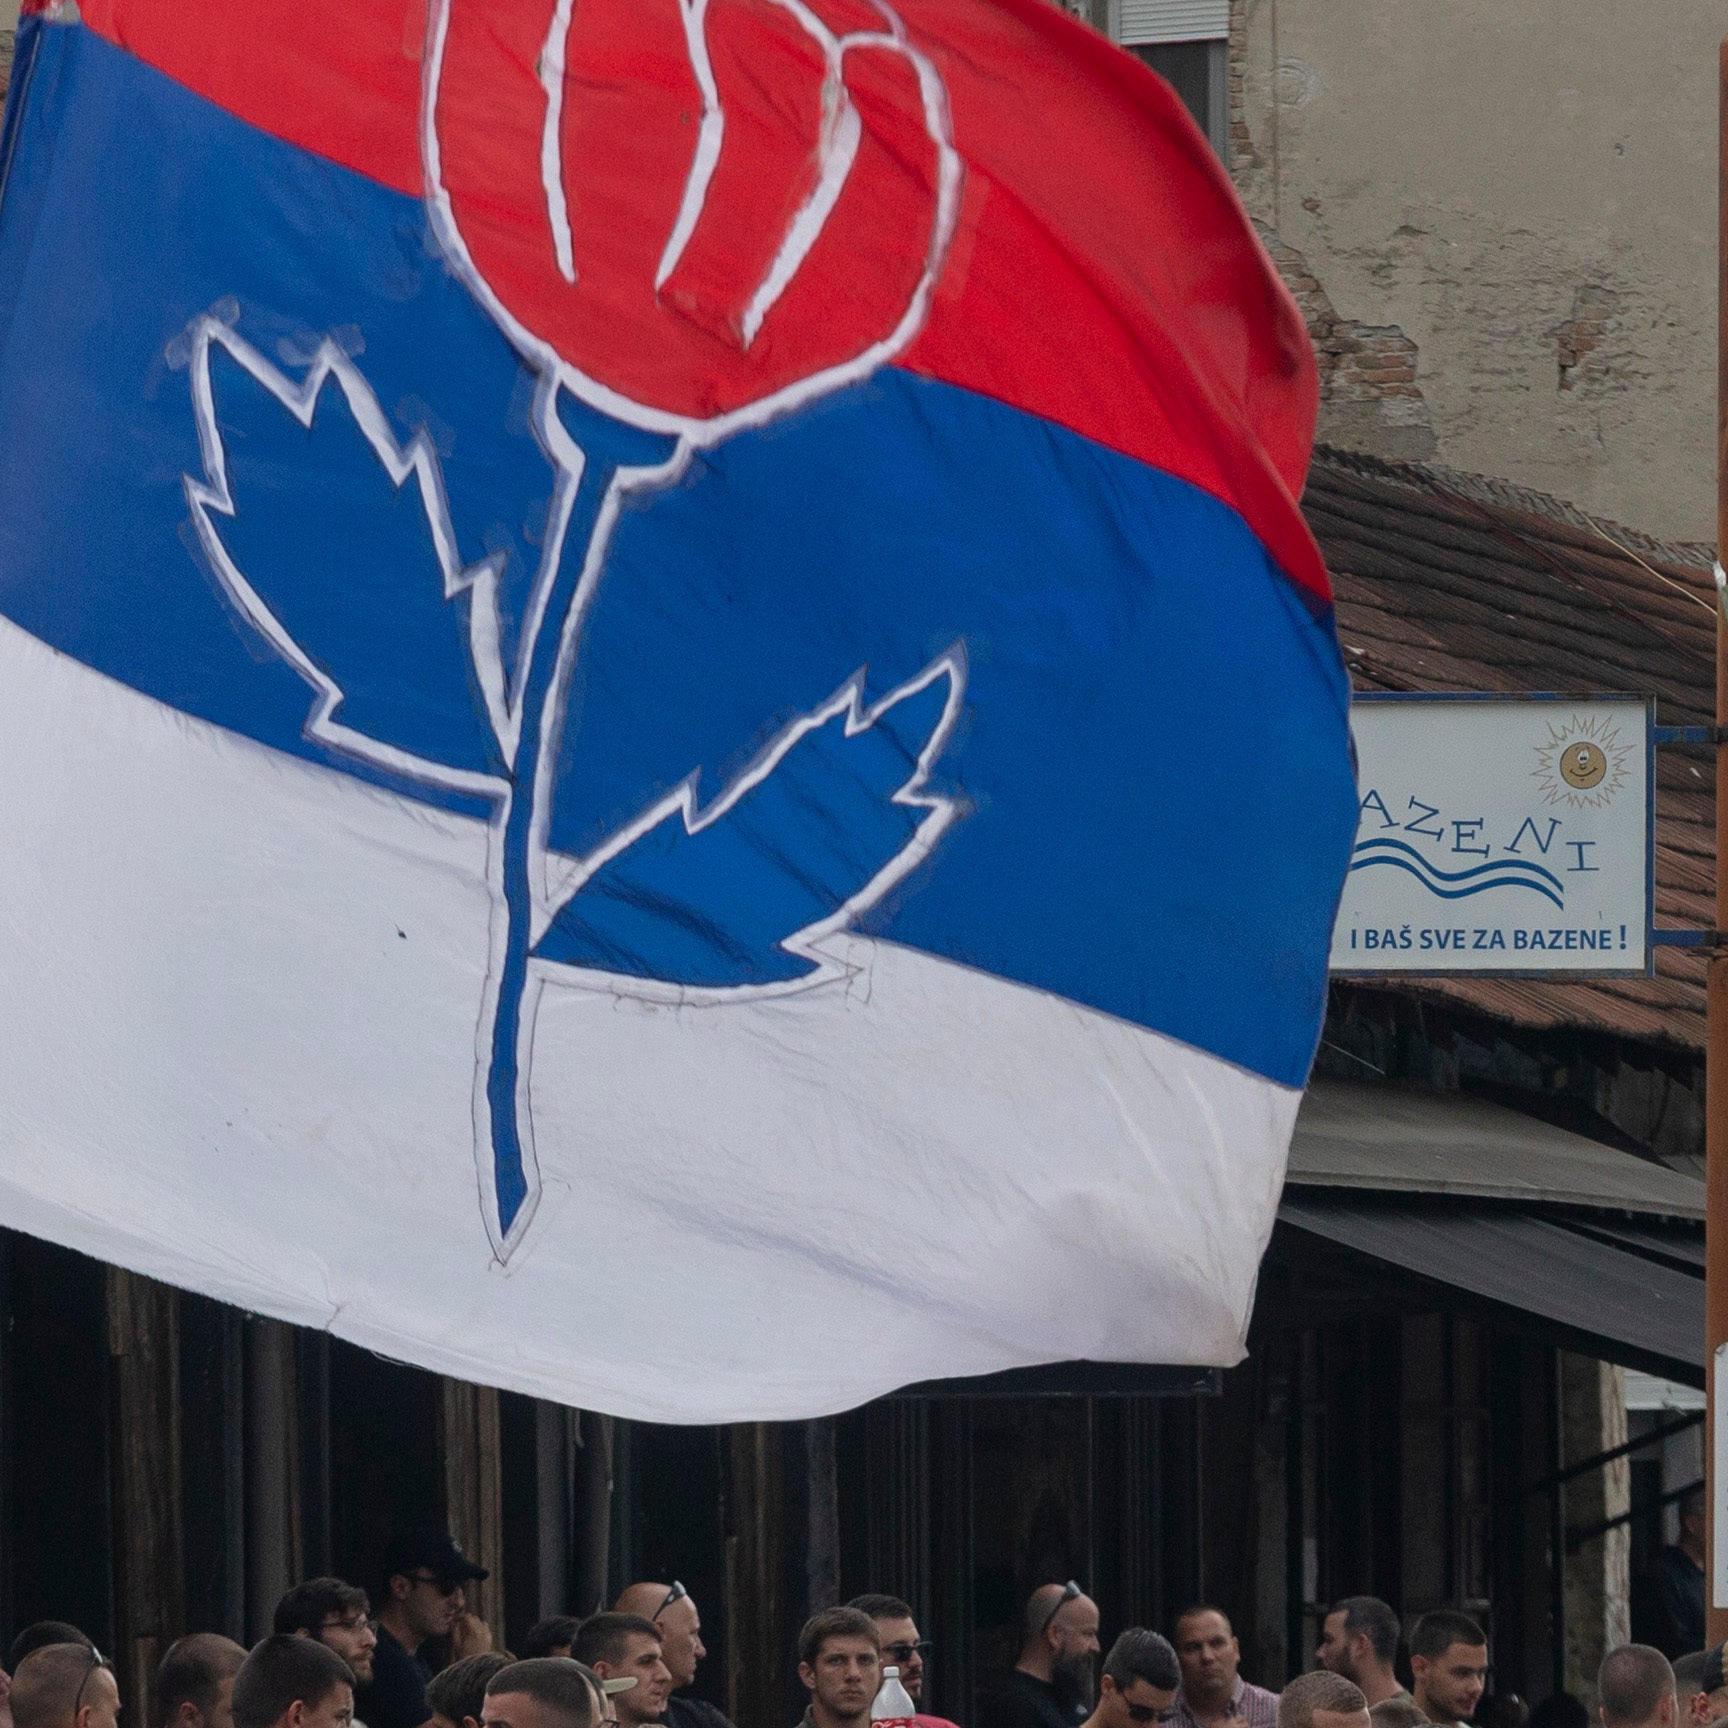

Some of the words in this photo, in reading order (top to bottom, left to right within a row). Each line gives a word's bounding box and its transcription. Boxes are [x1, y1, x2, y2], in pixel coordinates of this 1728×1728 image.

[1362, 789, 1600, 872] AZENI
[1351, 929, 1357, 949] I
[1364, 925, 1412, 949] BAŠ
[1420, 929, 1465, 949] SVE
[1473, 929, 1506, 949] ZA
[1514, 929, 1612, 950] BAZENE
